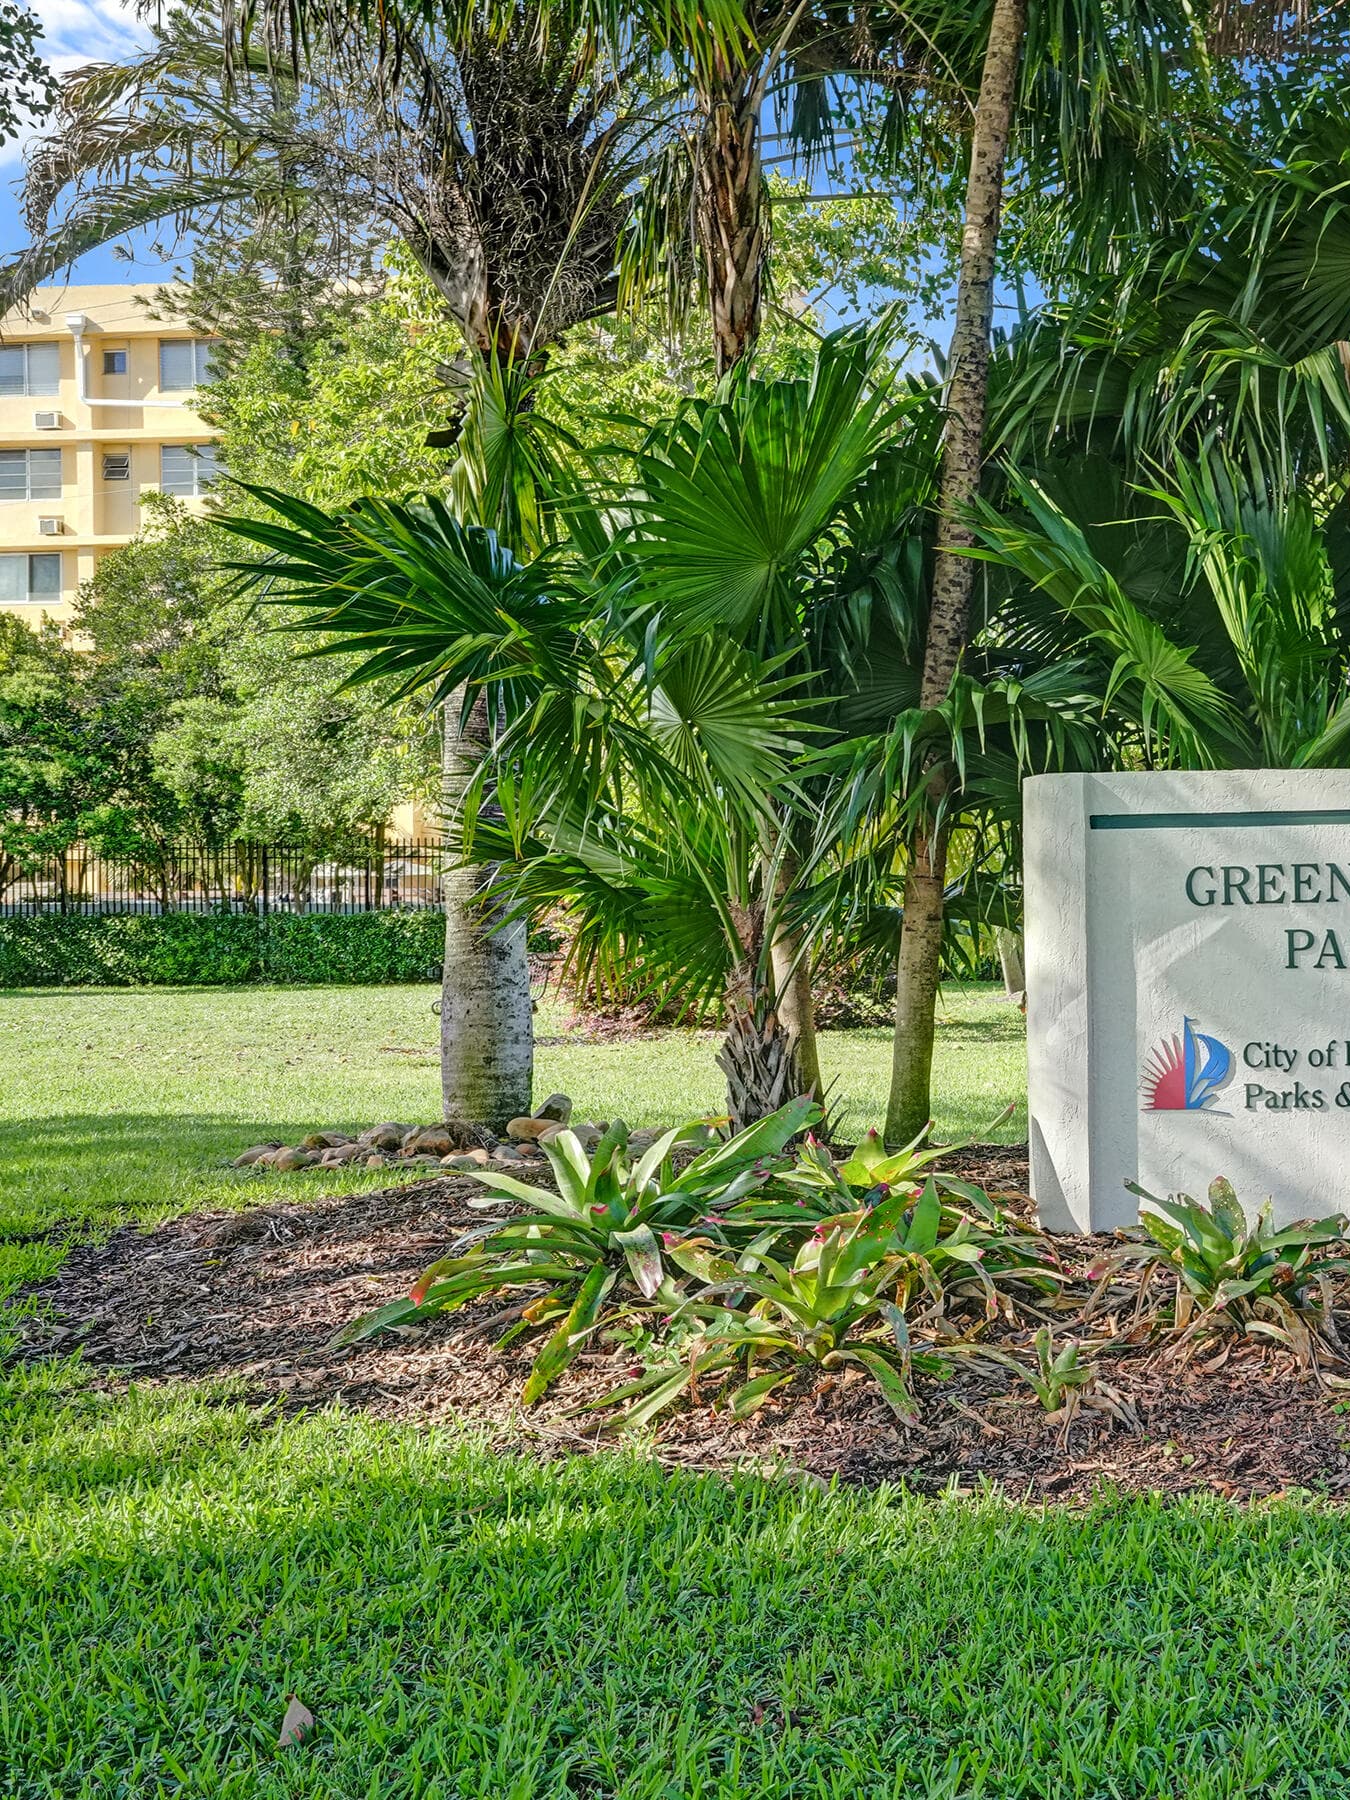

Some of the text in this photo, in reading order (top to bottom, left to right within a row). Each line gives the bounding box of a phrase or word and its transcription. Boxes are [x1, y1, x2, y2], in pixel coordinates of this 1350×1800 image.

[1243, 1042, 1298, 1073] City
[1308, 1039, 1337, 1067] of
[1243, 1081, 1325, 1109] Parks
